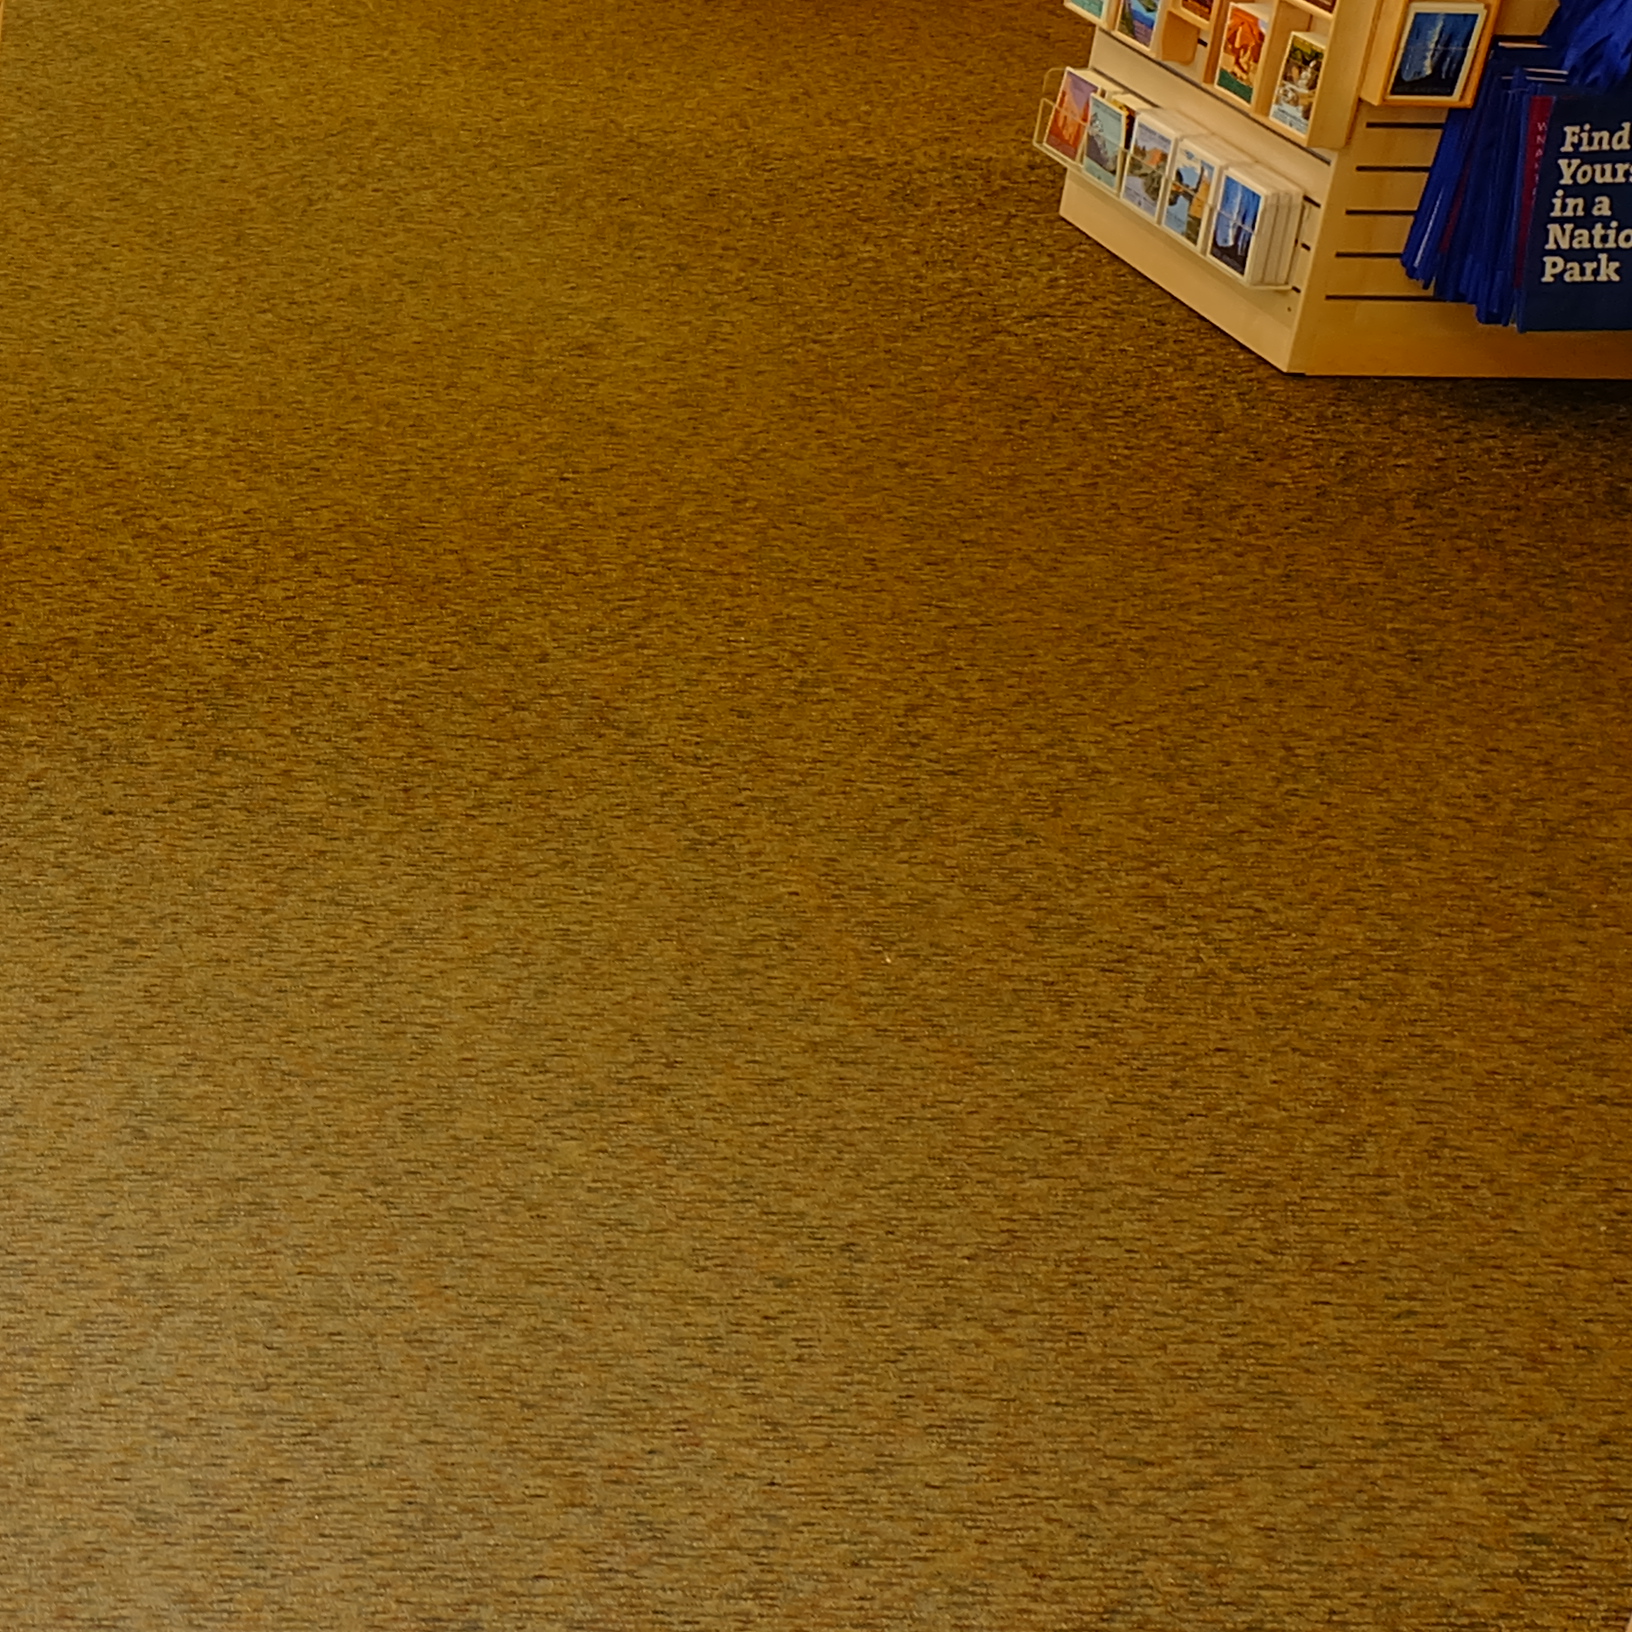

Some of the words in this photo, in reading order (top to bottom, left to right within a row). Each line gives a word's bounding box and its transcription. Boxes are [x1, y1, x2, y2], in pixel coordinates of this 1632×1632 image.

[1560, 121, 1631, 152] Find
[1549, 189, 1584, 217] in
[1592, 195, 1612, 216] a
[1541, 253, 1621, 282] Park
